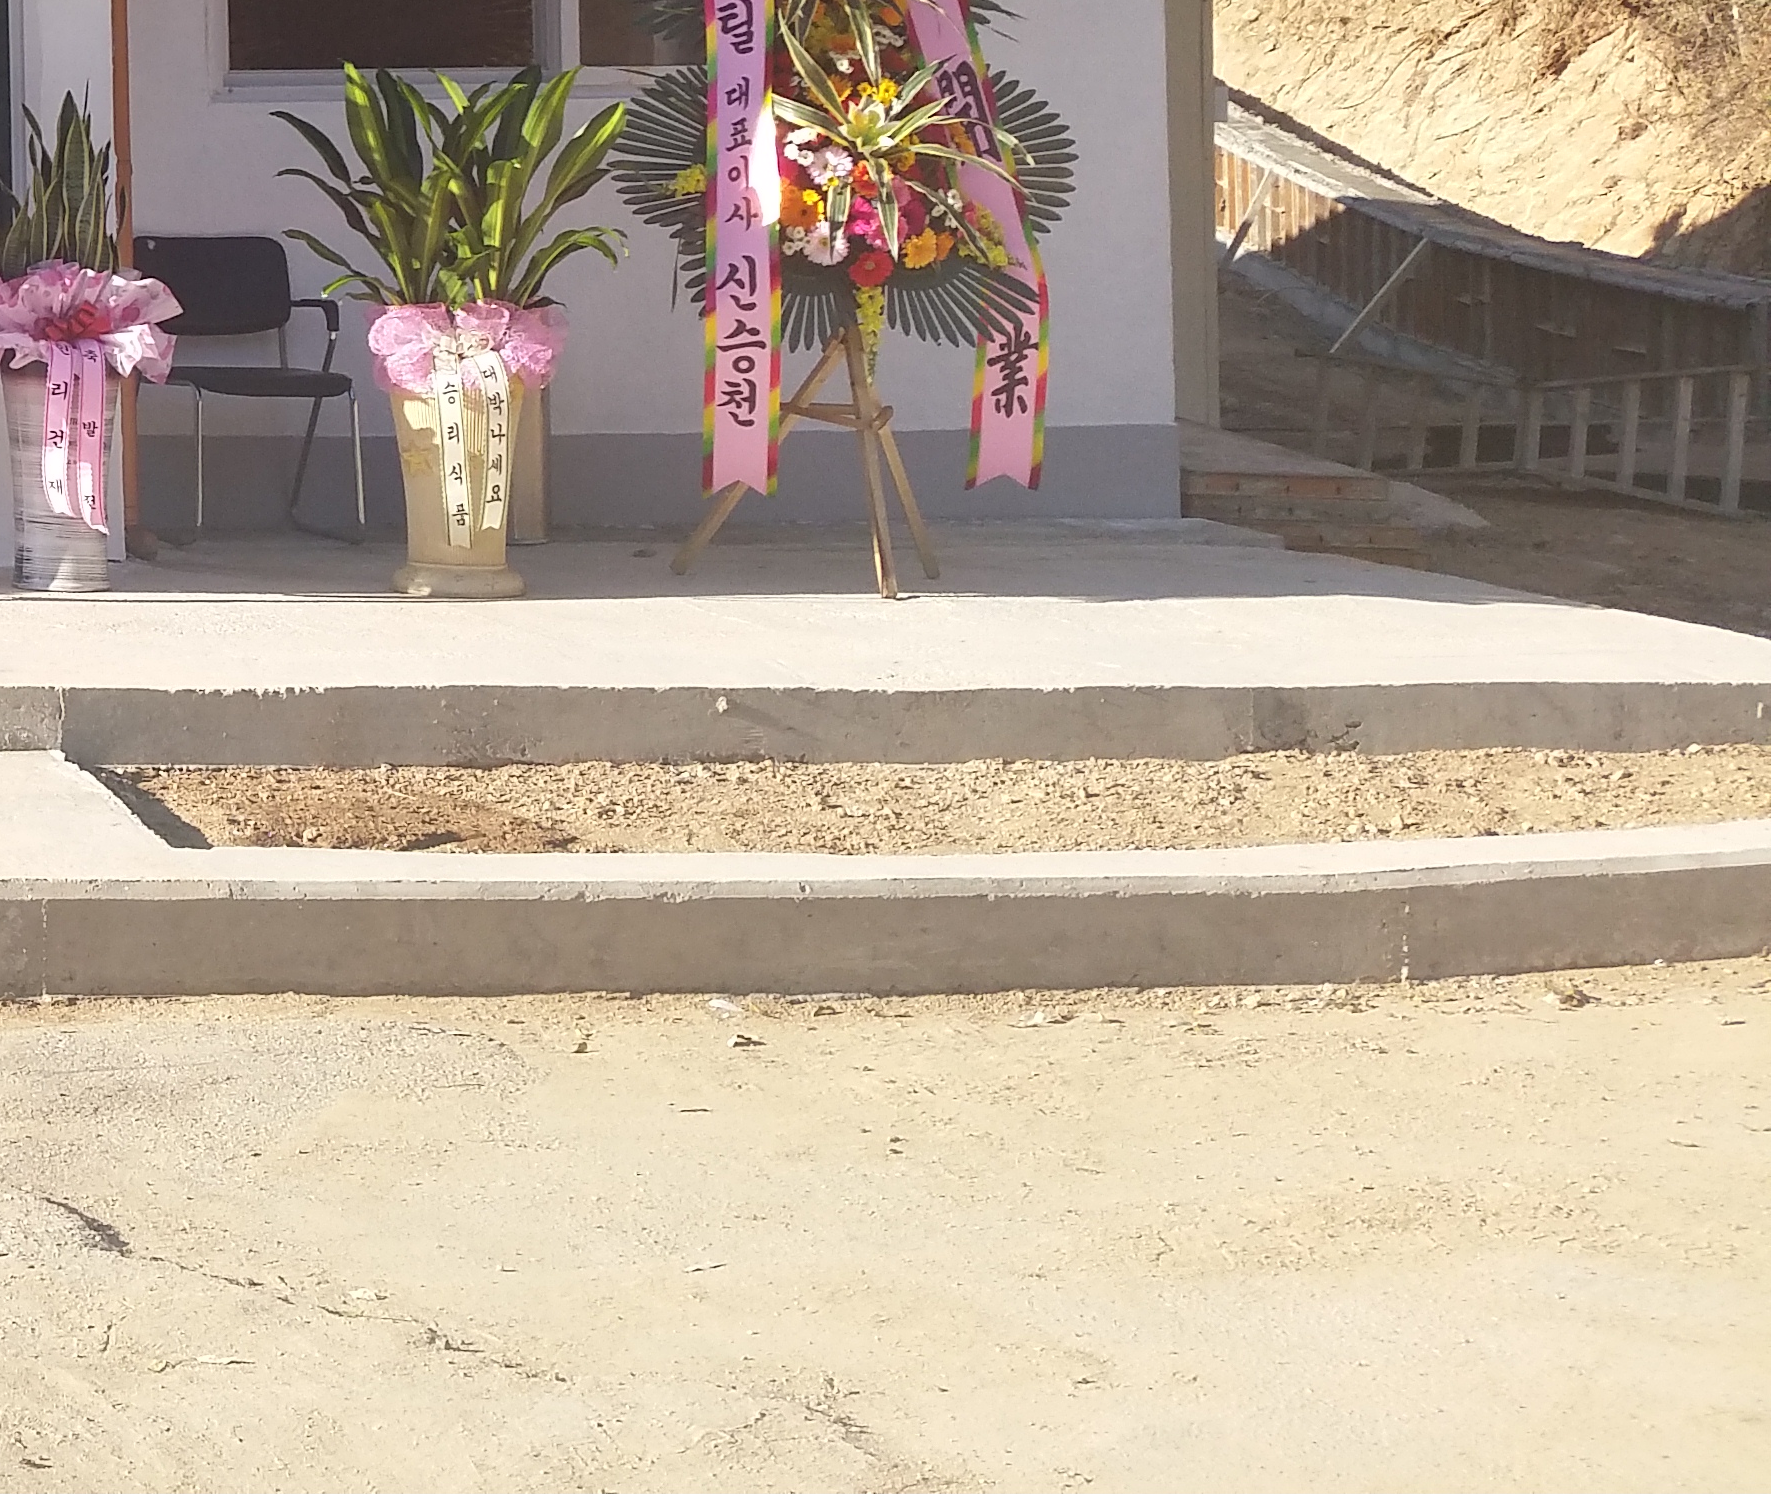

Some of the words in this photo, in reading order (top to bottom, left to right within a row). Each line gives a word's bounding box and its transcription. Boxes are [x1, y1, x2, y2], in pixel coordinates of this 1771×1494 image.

[725, 76, 759, 232] 대표이사
[716, 255, 767, 428] 신승천
[442, 381, 468, 526] 승리식품
[481, 365, 505, 504] 대박나세요
